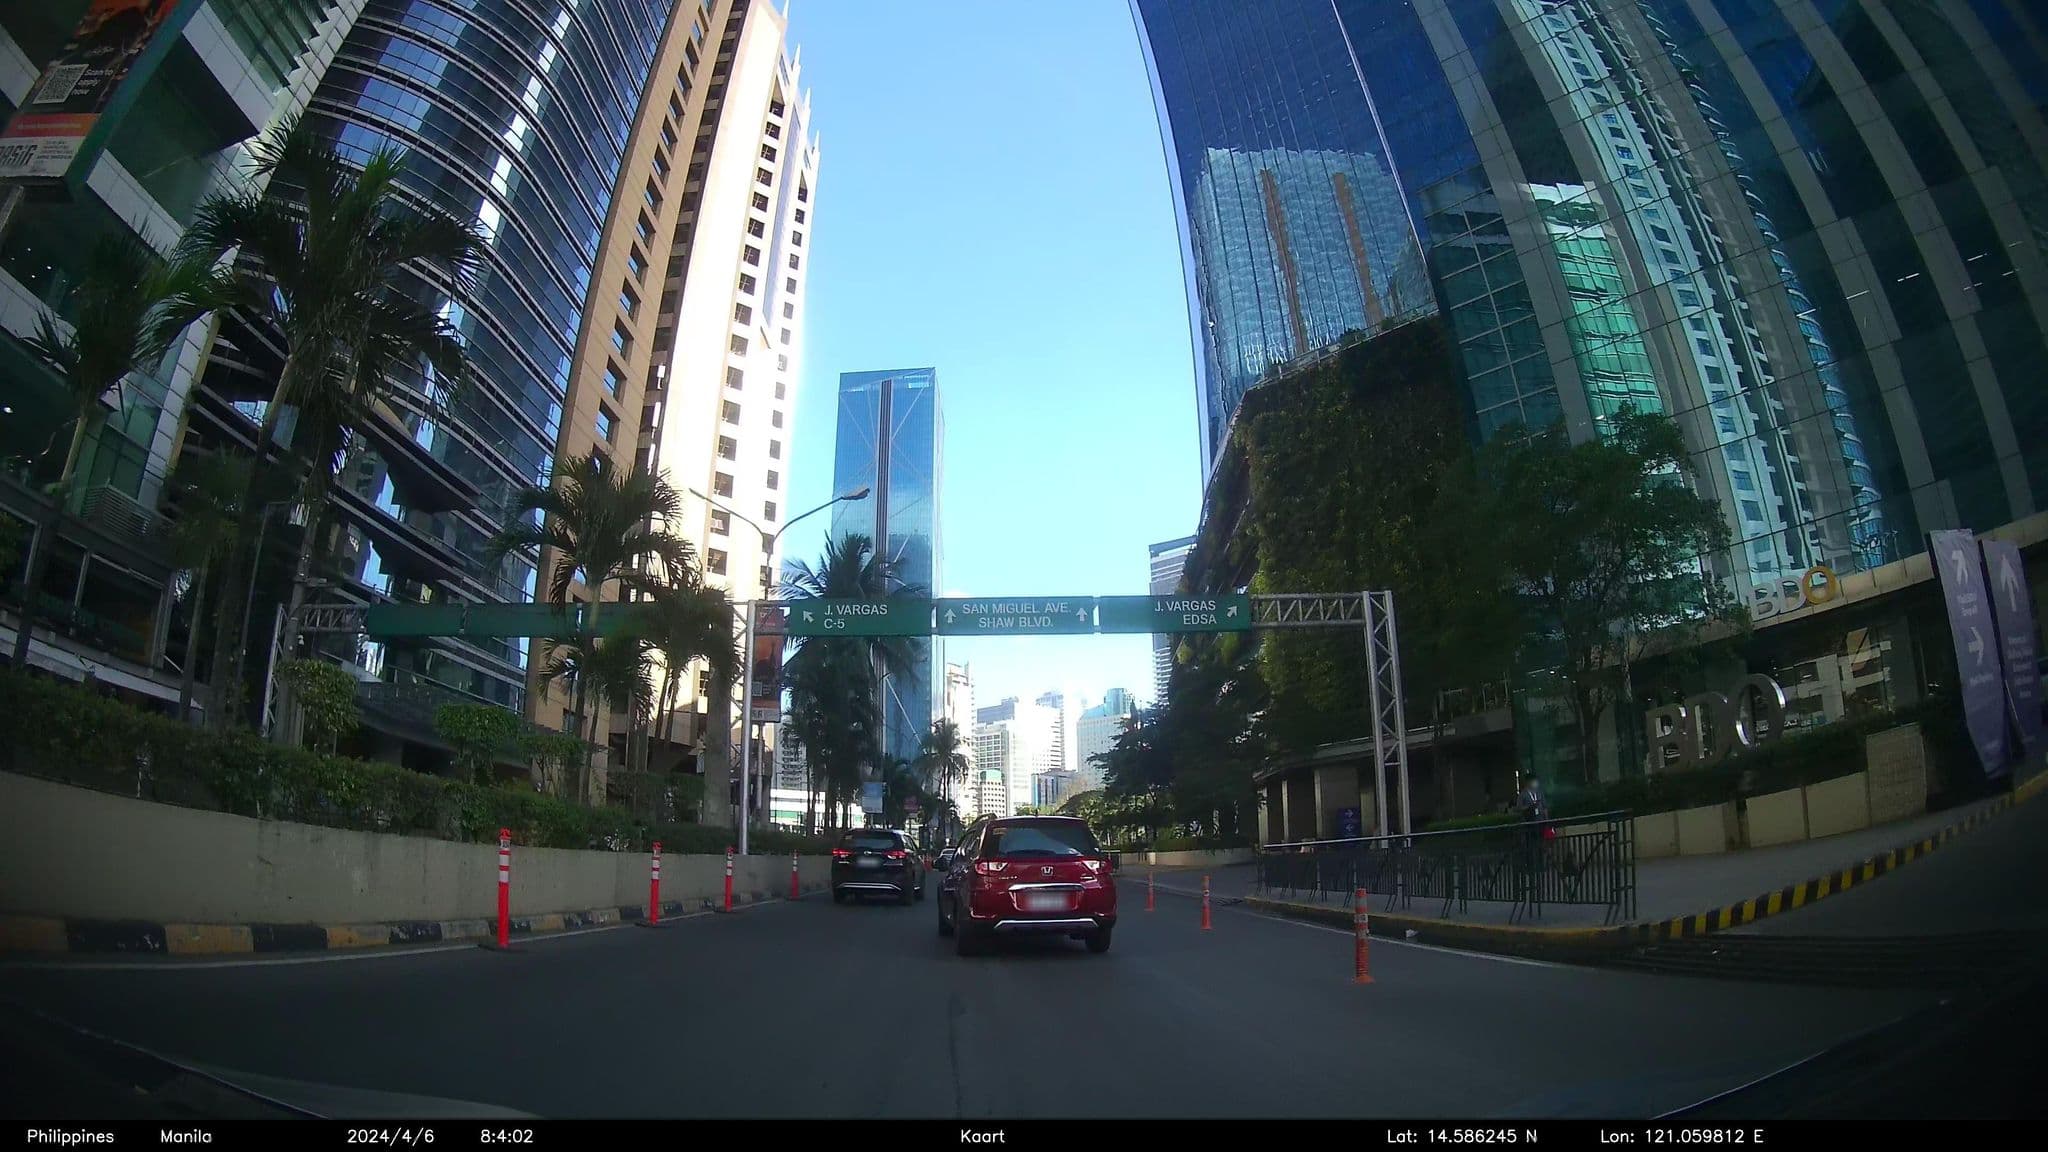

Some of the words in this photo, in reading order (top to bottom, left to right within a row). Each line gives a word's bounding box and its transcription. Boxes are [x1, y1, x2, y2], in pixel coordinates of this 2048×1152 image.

[1750, 565, 1838, 622] BDO
[824, 604, 833, 616] J.
[836, 604, 888, 616] VARGAS
[962, 603, 989, 615] SAN
[992, 602, 1040, 615] MIGUEL
[1044, 602, 1072, 614] AVE.
[1154, 601, 1164, 612] J.
[1165, 600, 1217, 612] VARGAS
[823, 618, 846, 629] C-5
[978, 617, 1014, 629] SHAW
[1018, 616, 1054, 628] BLVD.
[1183, 614, 1218, 625] EDSA
[1645, 673, 1786, 776] BDO
